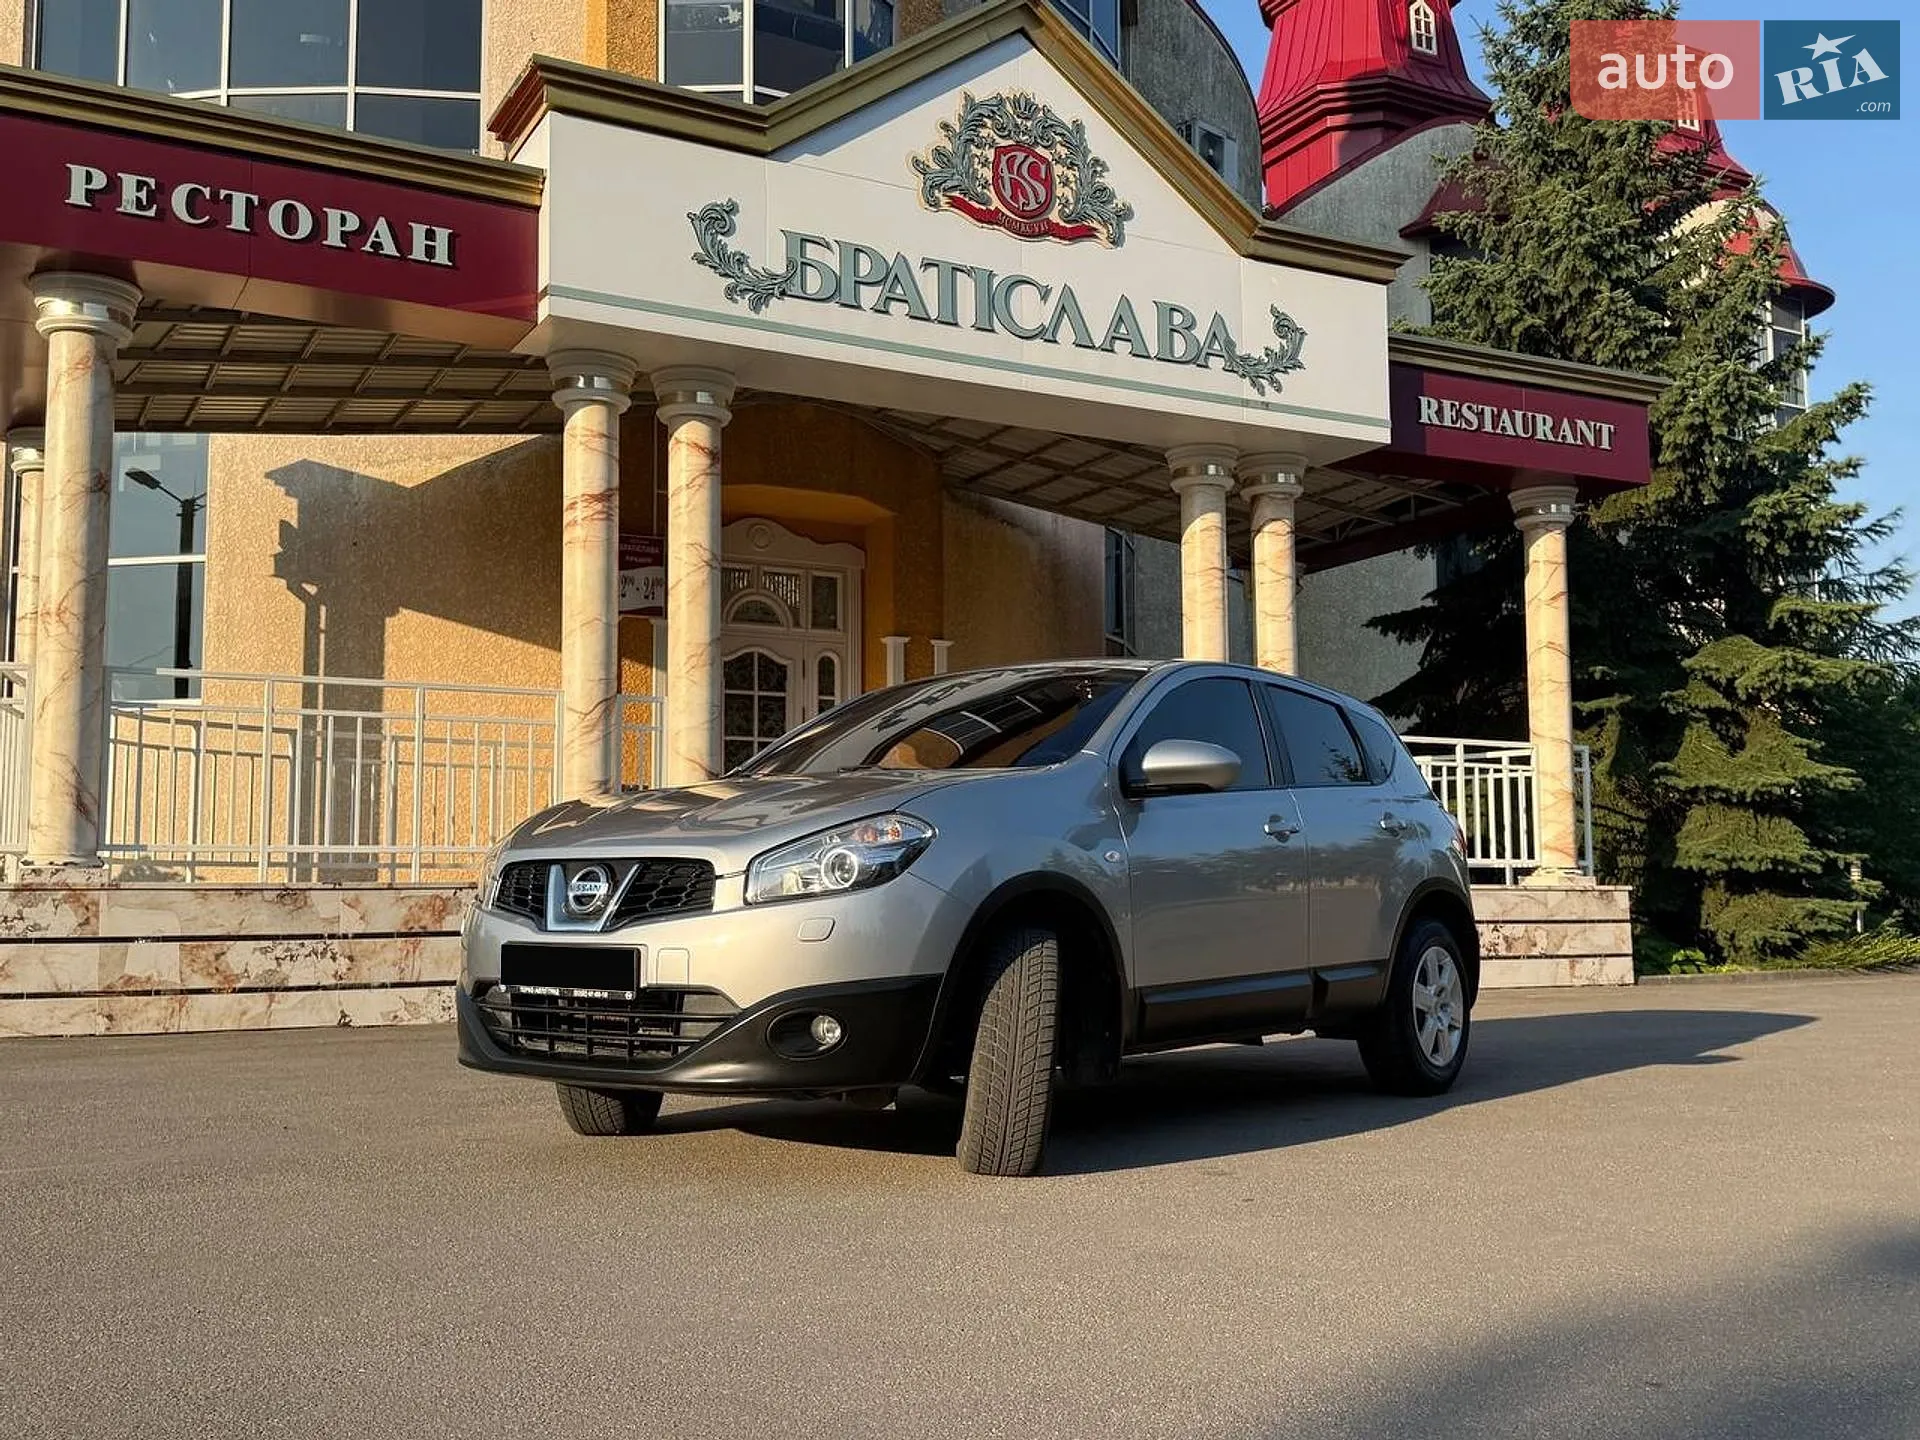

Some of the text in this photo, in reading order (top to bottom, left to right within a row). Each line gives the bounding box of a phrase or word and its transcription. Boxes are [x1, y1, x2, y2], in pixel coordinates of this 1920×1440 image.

[64, 162, 454, 267] РЕСТОРАН
[779, 229, 1241, 374] БРАТІСЛАВА
[1418, 395, 1615, 450] RESTAURANT
